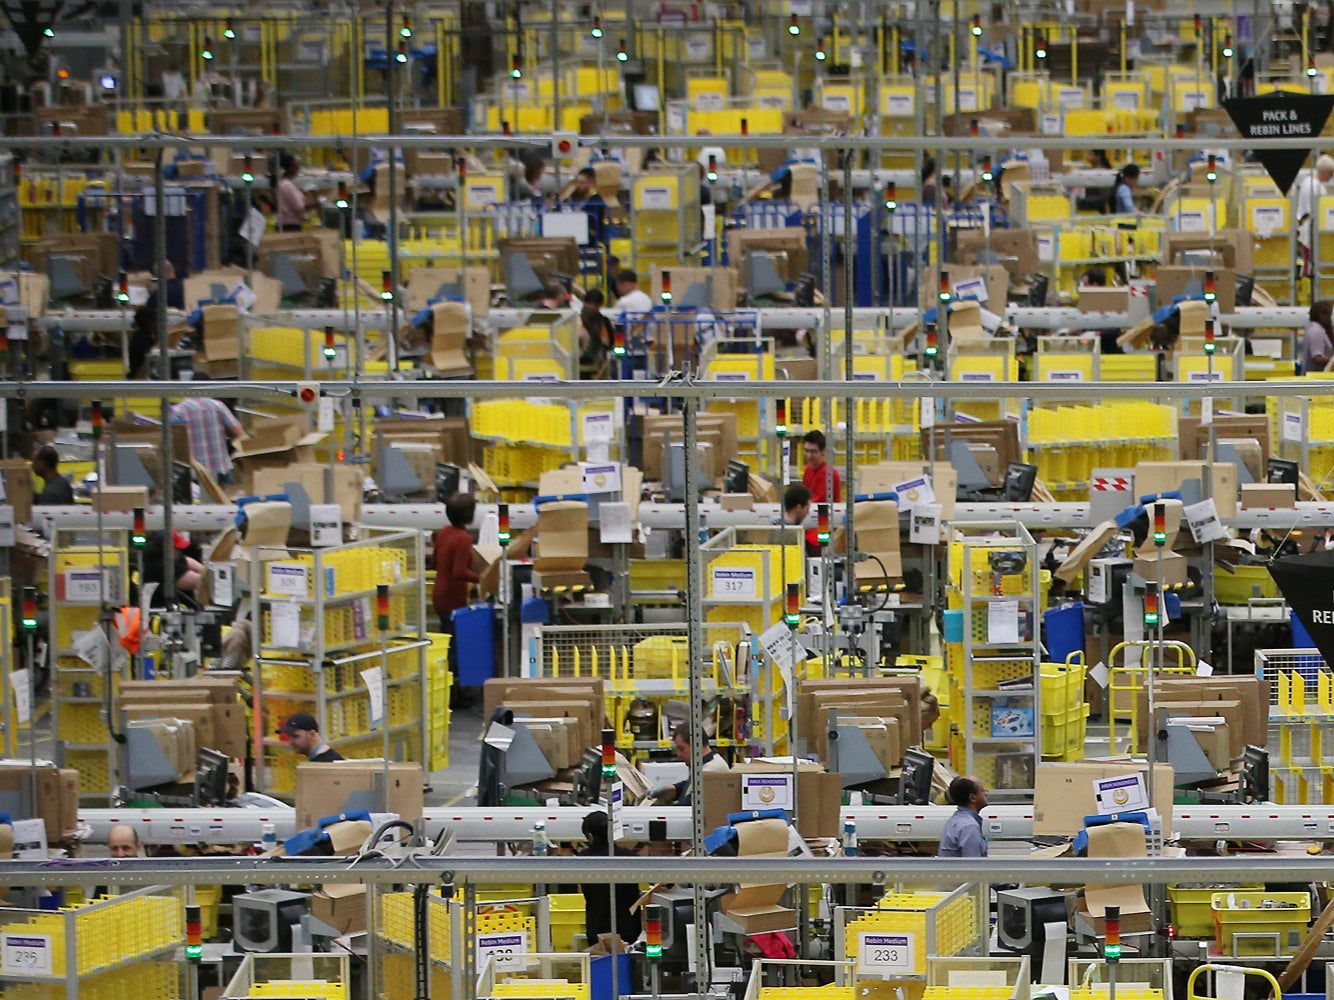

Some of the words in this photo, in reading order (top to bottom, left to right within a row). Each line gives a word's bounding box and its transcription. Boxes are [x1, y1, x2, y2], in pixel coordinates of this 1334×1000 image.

[1263, 110, 1288, 121] PACK
[1289, 110, 1298, 120] &
[1250, 125, 1280, 135] REBIN
[1283, 122, 1312, 134] LINES
[725, 582, 743, 591] 317
[874, 949, 898, 961] 233
